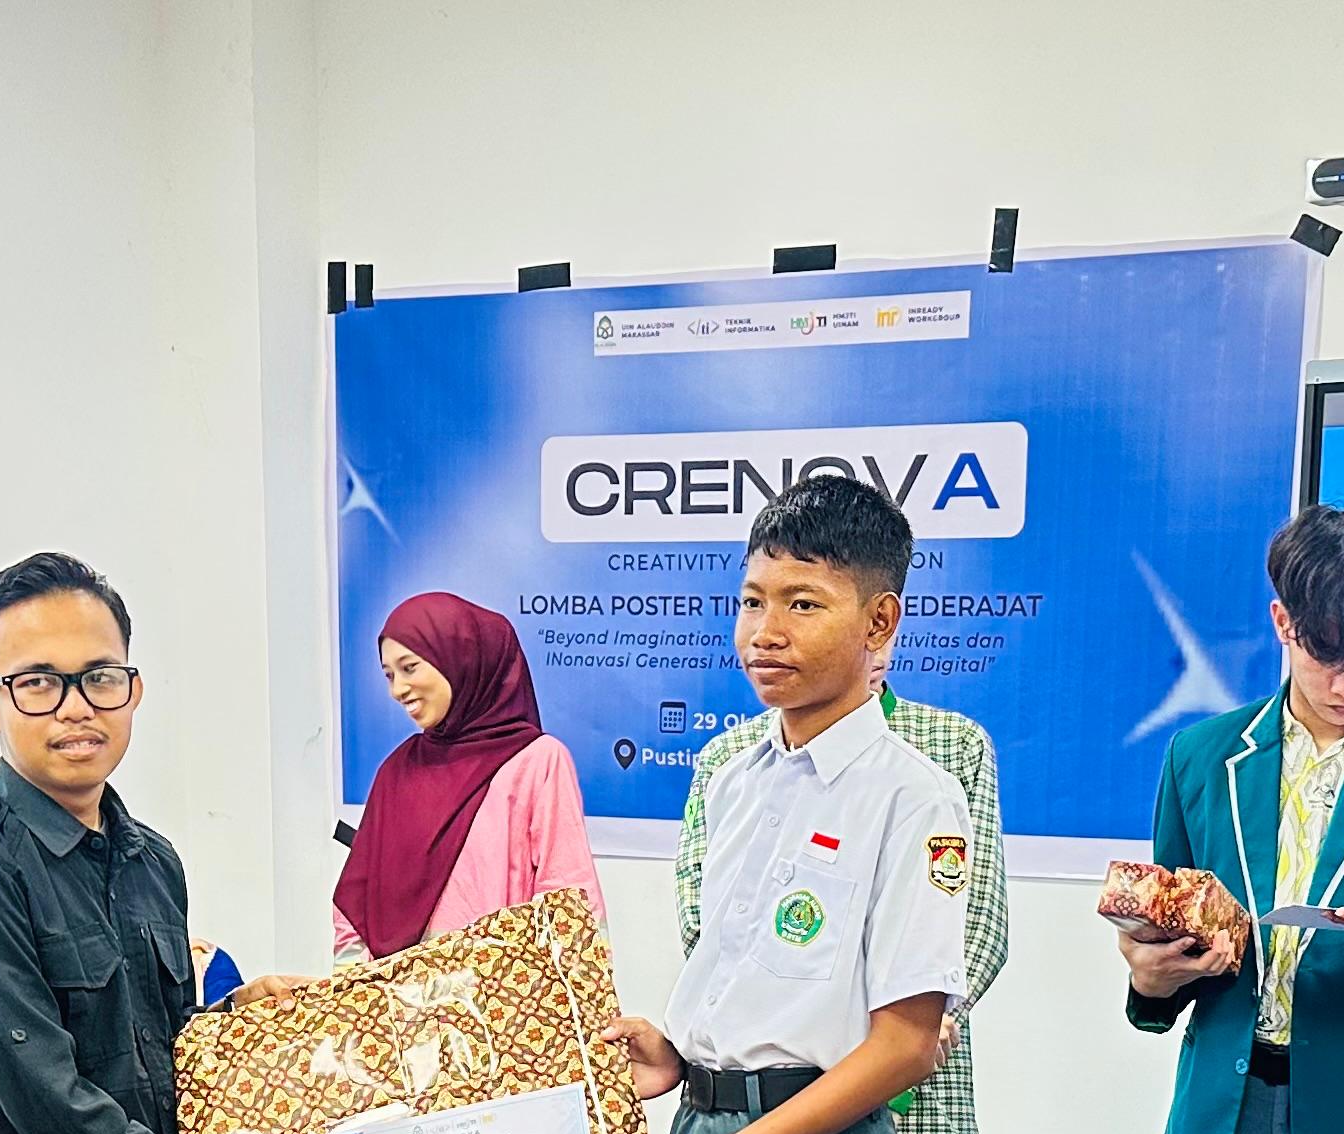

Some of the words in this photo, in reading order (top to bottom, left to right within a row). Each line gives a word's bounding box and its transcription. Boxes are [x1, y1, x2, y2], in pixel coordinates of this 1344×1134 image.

[725, 325, 776, 333] INFORMATIKA
[607, 553, 731, 572] CREATIVITY
[519, 595, 604, 616] LOMBA
[611, 595, 703, 617] POSTER
[905, 595, 1043, 617] EDERAJAT
[613, 629, 728, 650] Imagination:
[966, 631, 1005, 649] dan
[545, 652, 631, 669] INonavasi
[635, 653, 714, 669] Generasi
[693, 712, 717, 730] 29
